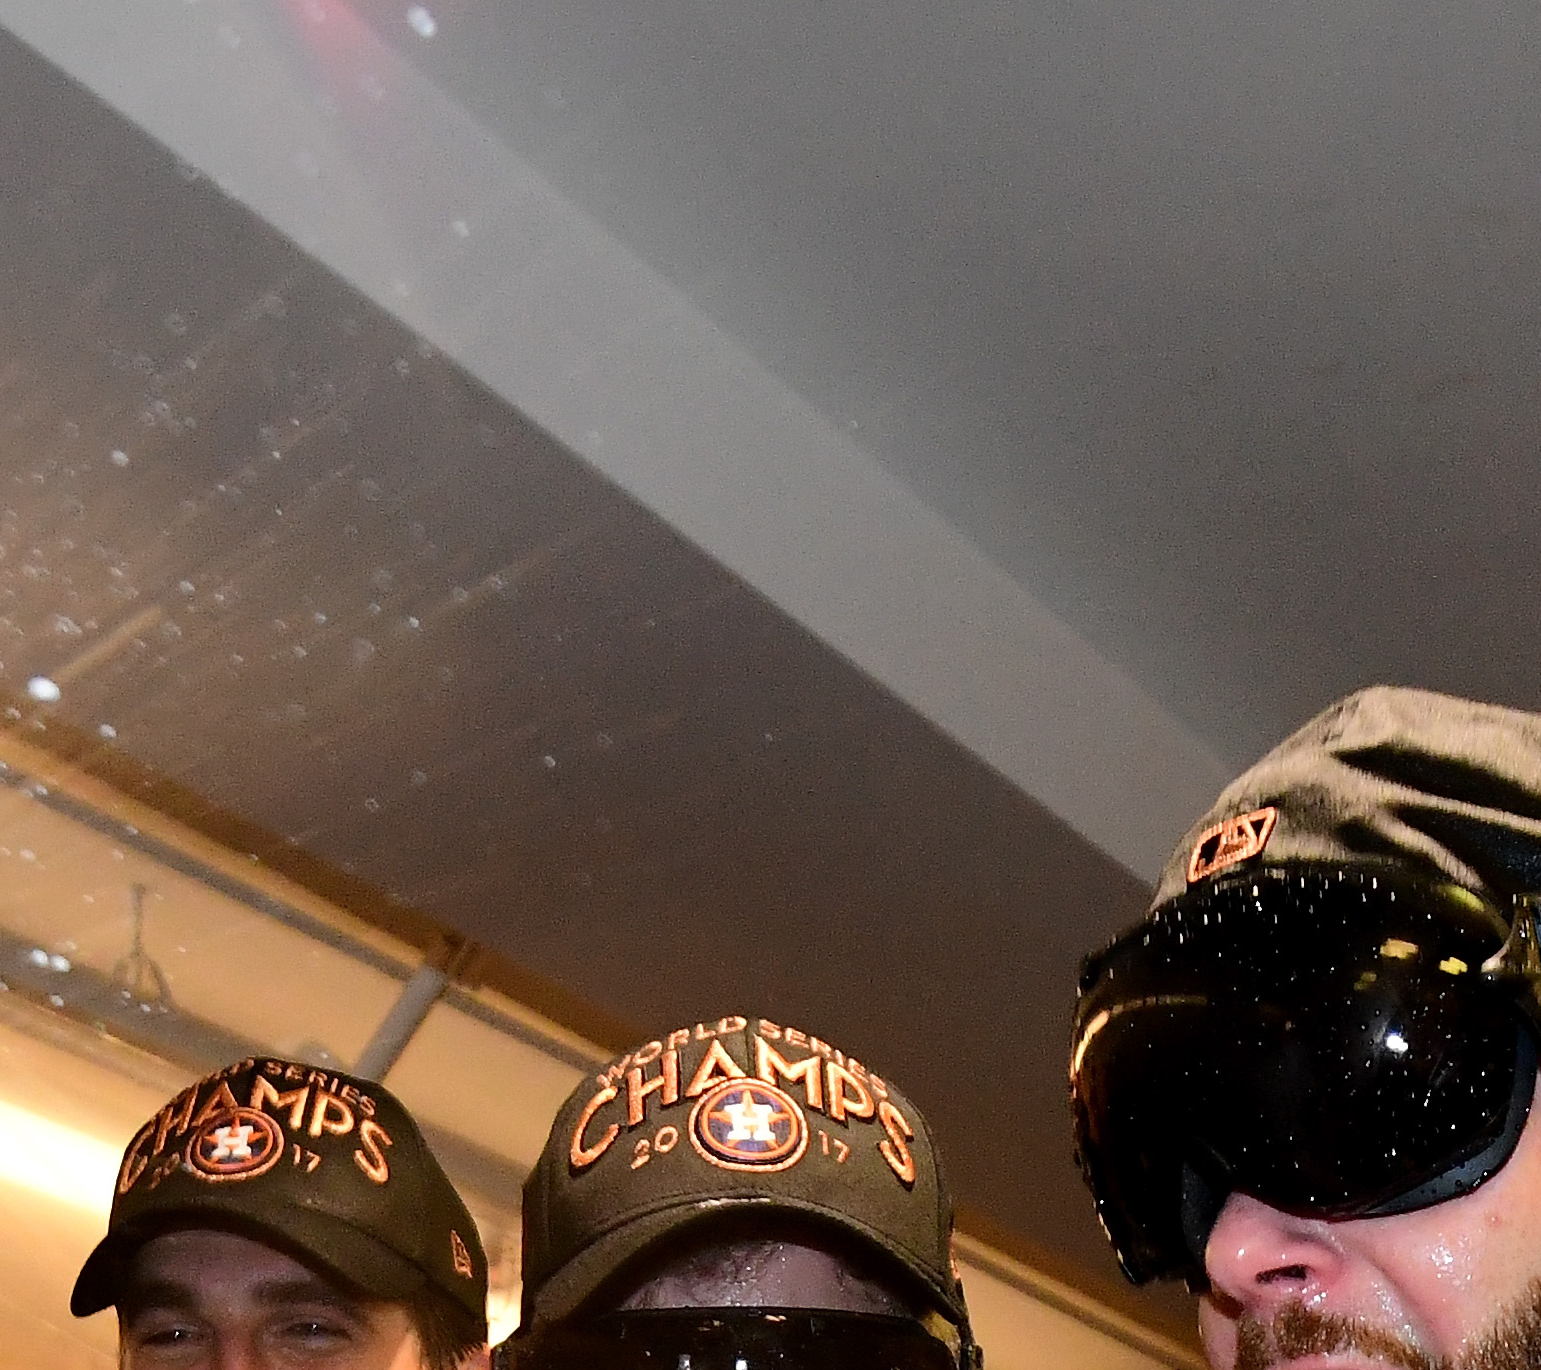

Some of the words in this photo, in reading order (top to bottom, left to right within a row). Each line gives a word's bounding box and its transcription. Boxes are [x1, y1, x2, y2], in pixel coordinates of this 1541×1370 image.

[596, 1015, 747, 1088] WORLD
[759, 1019, 888, 1099] SERIES
[266, 1060, 376, 1117] SERIES
[570, 1038, 915, 1184] CHAMPS
[118, 1074, 393, 1195] CHAMPS
[292, 1143, 322, 1174] 17
[631, 1126, 679, 1170] 20
[818, 1130, 851, 1164] 17
